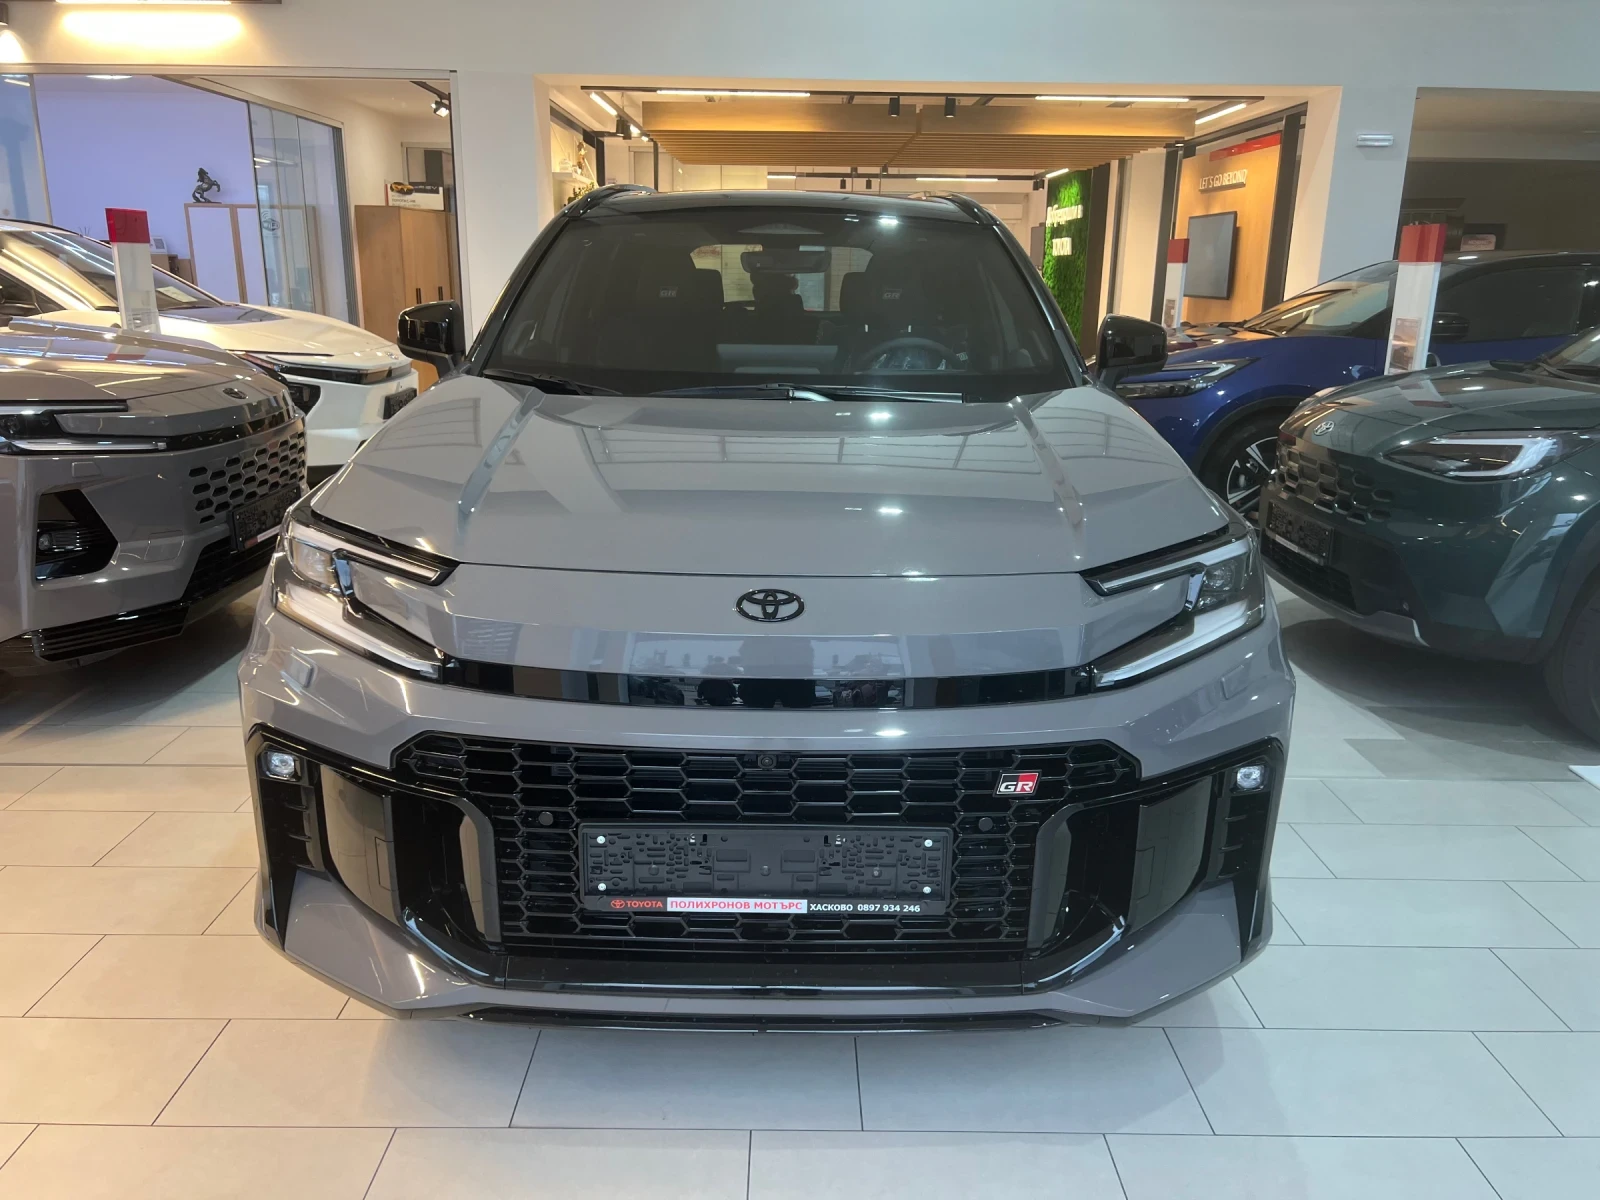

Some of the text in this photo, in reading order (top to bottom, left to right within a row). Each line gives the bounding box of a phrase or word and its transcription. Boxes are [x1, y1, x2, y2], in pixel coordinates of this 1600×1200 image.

[1199, 175, 1214, 190] LET'S
[1213, 173, 1223, 187] GO
[999, 781, 1034, 792] GR
[626, 900, 663, 908] TOYOTA
[670, 900, 751, 909] ПОЛИХРОНОВ
[754, 901, 802, 910] МОТЪРС
[810, 903, 853, 911] ХАСКОВО
[857, 904, 880, 912] 0897
[883, 904, 901, 912] 934
